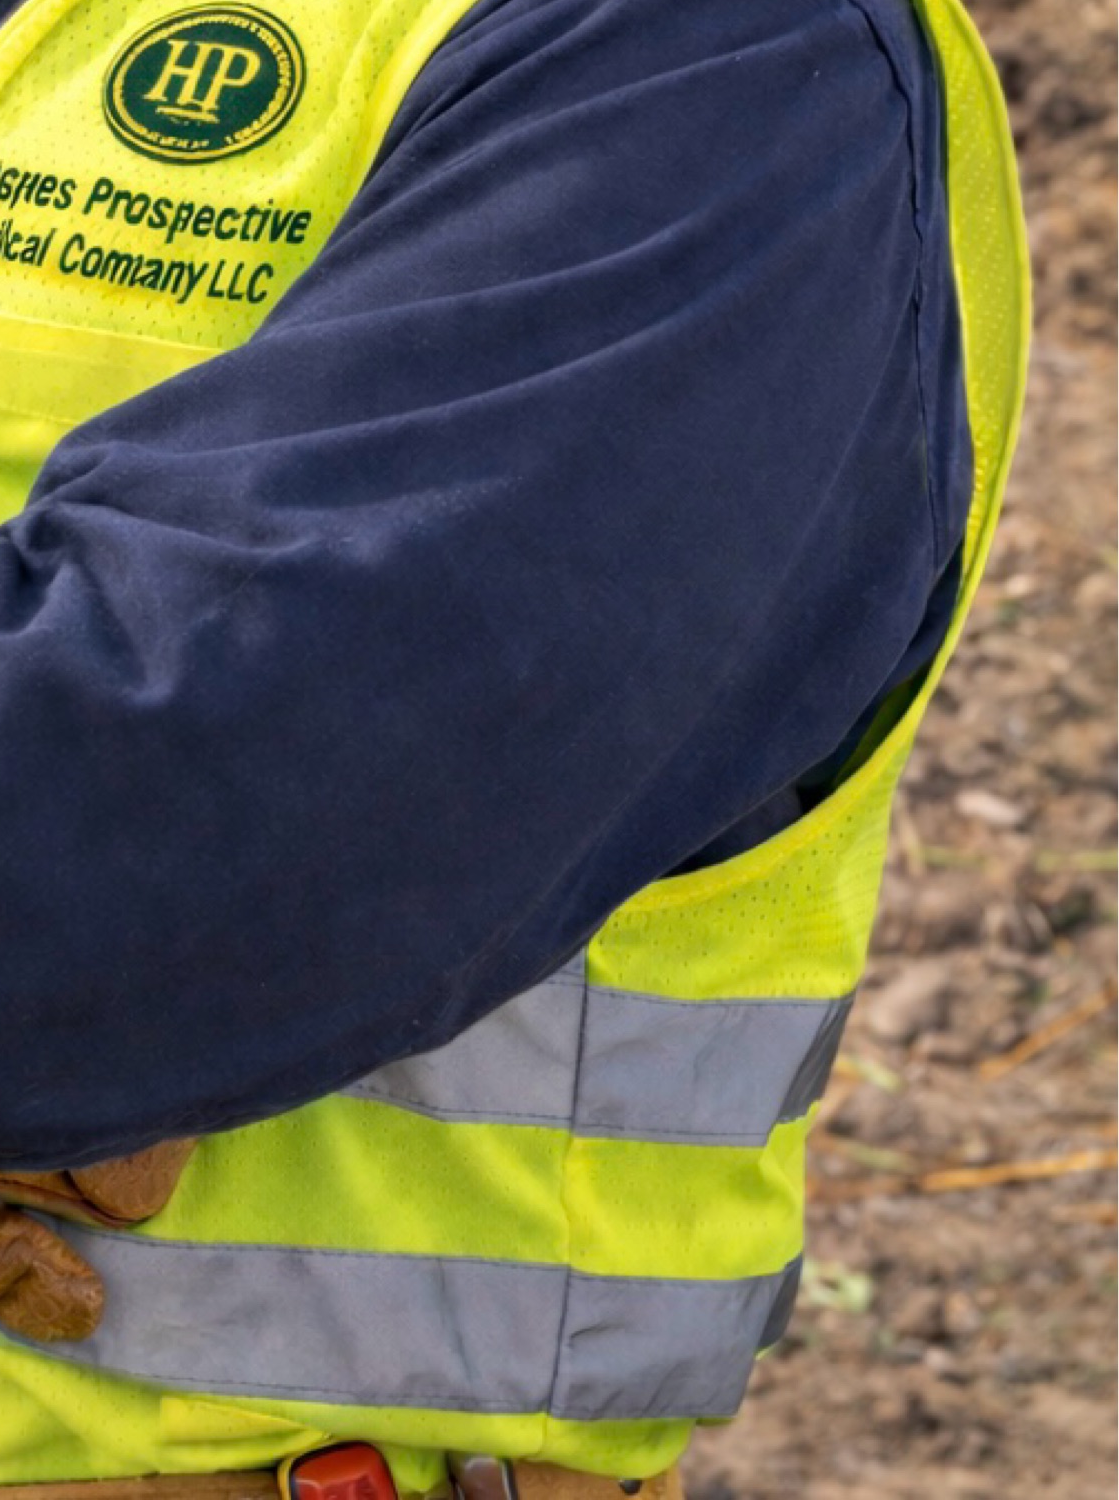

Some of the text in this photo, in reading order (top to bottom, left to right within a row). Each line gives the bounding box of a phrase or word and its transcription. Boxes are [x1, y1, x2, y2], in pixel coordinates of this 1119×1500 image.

[141, 38, 262, 112] HP
[81, 176, 312, 245] Prospective
[206, 258, 275, 304] LLC
